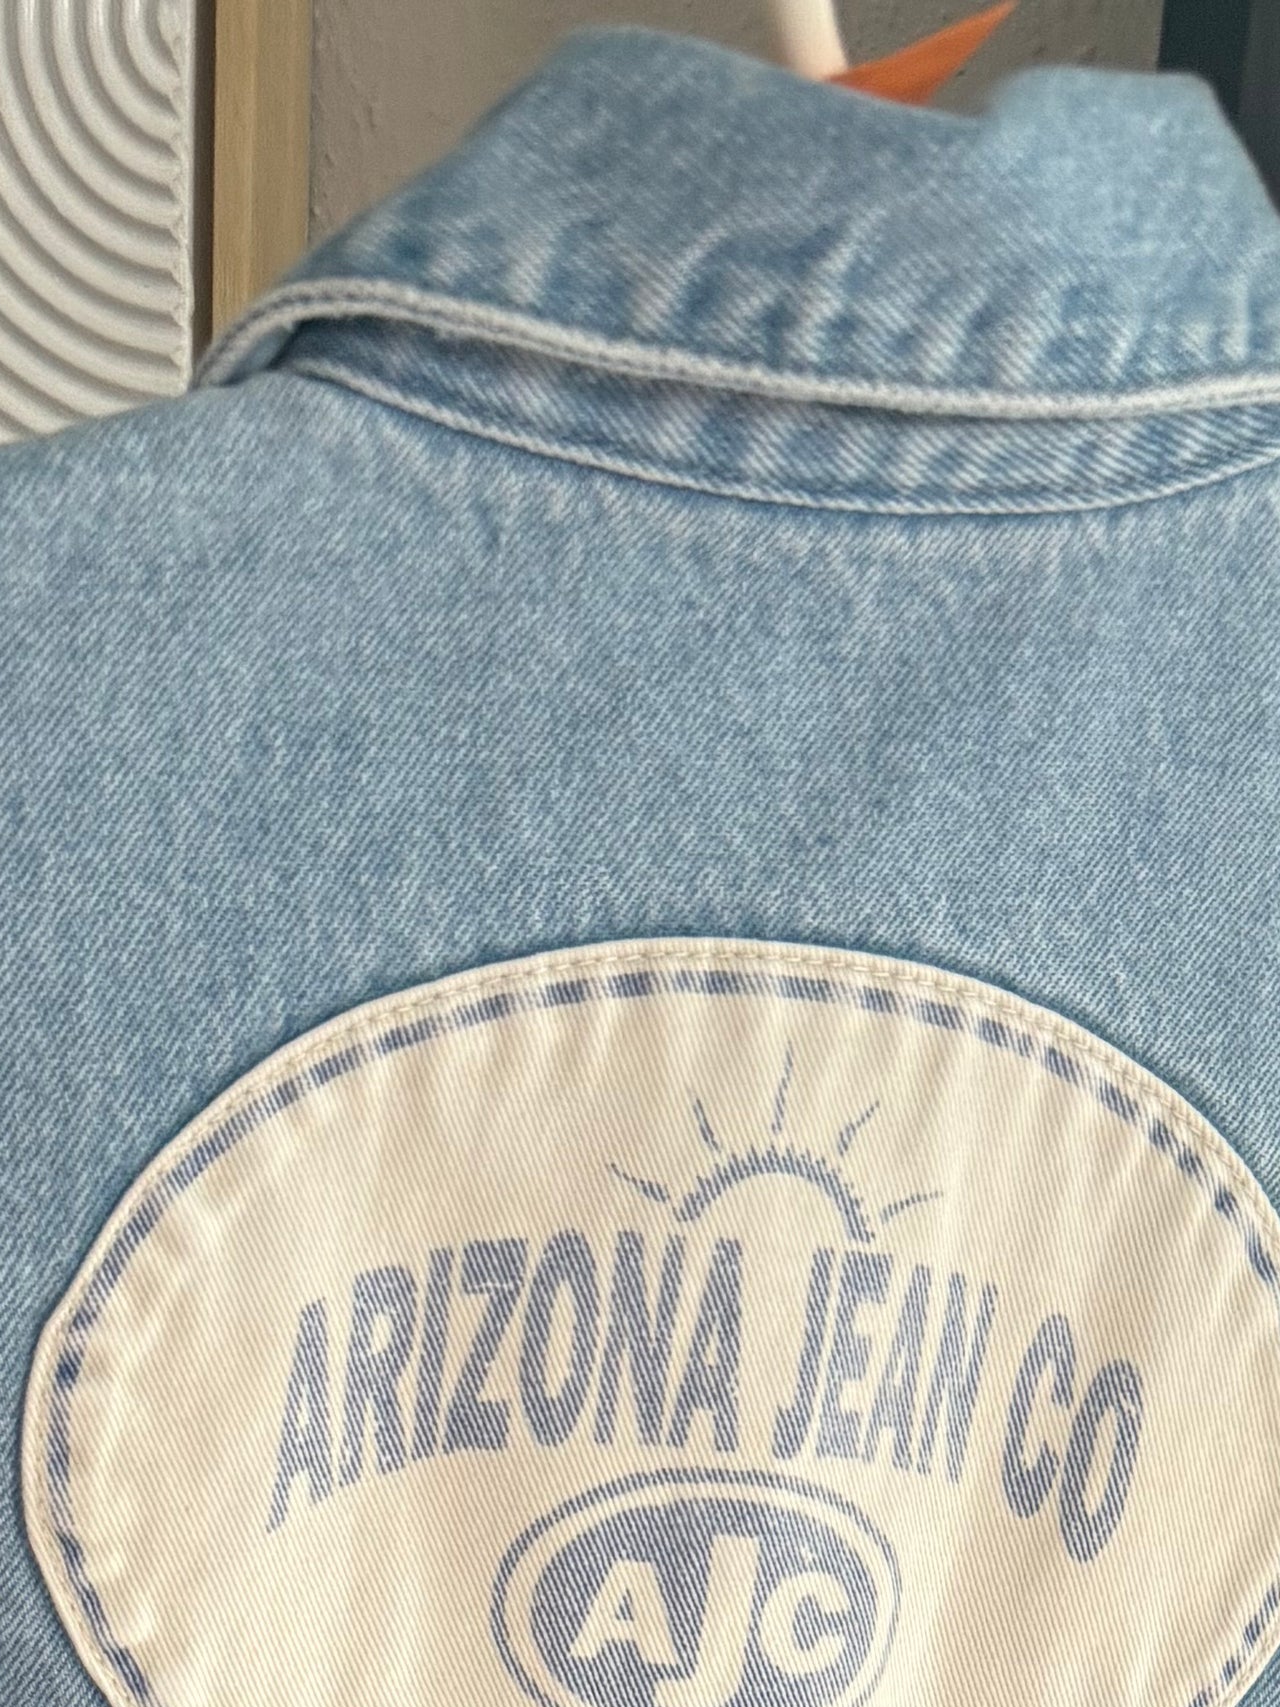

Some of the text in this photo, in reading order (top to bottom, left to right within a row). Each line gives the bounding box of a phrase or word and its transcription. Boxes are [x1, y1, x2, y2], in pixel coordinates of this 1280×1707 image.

[266, 1227, 1146, 1563] ARIZONA JEAN CO
